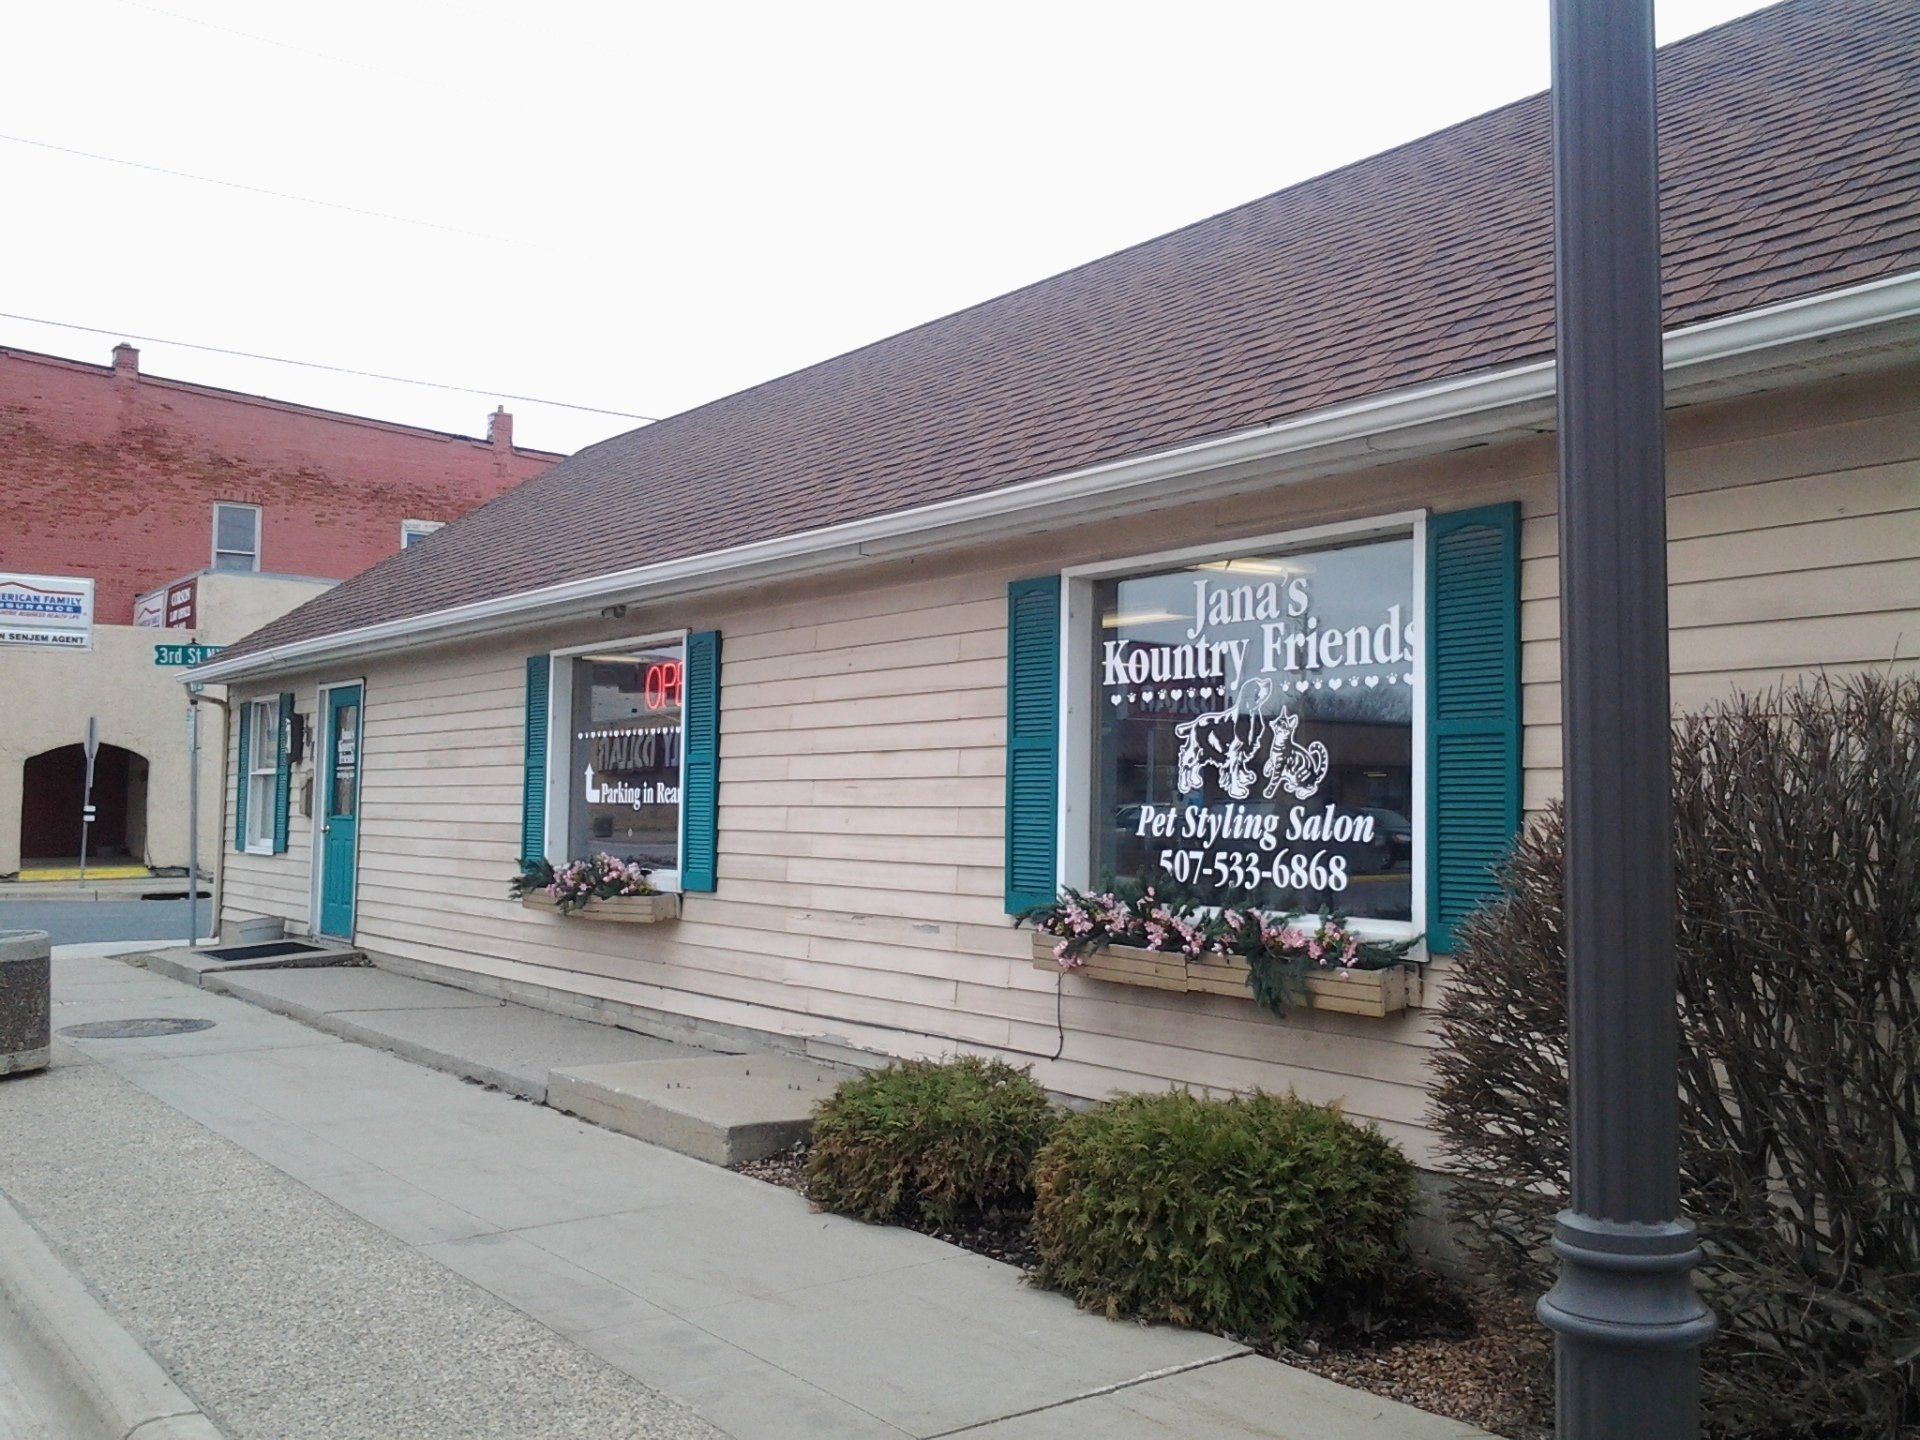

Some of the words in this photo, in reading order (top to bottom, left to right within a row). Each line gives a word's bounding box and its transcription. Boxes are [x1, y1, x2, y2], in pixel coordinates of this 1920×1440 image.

[0, 593, 40, 604] ERICAN
[45, 596, 81, 606] FAMILY
[1187, 567, 1309, 640] Jana's
[9, 633, 49, 642] SENJEM
[52, 635, 85, 644] AGENT
[160, 647, 182, 664] 3rd
[187, 647, 201, 664] St
[206, 648, 223, 658] N
[1102, 635, 1250, 691] Kountry
[1260, 604, 1413, 674] Friends
[645, 662, 683, 709] OPE
[601, 781, 641, 811] Parking
[643, 780, 654, 804] in
[1136, 804, 1177, 838] Pet
[1181, 803, 1280, 851] Styling
[1285, 803, 1375, 843] Salon
[1159, 848, 1348, 892] 507-533-6868
